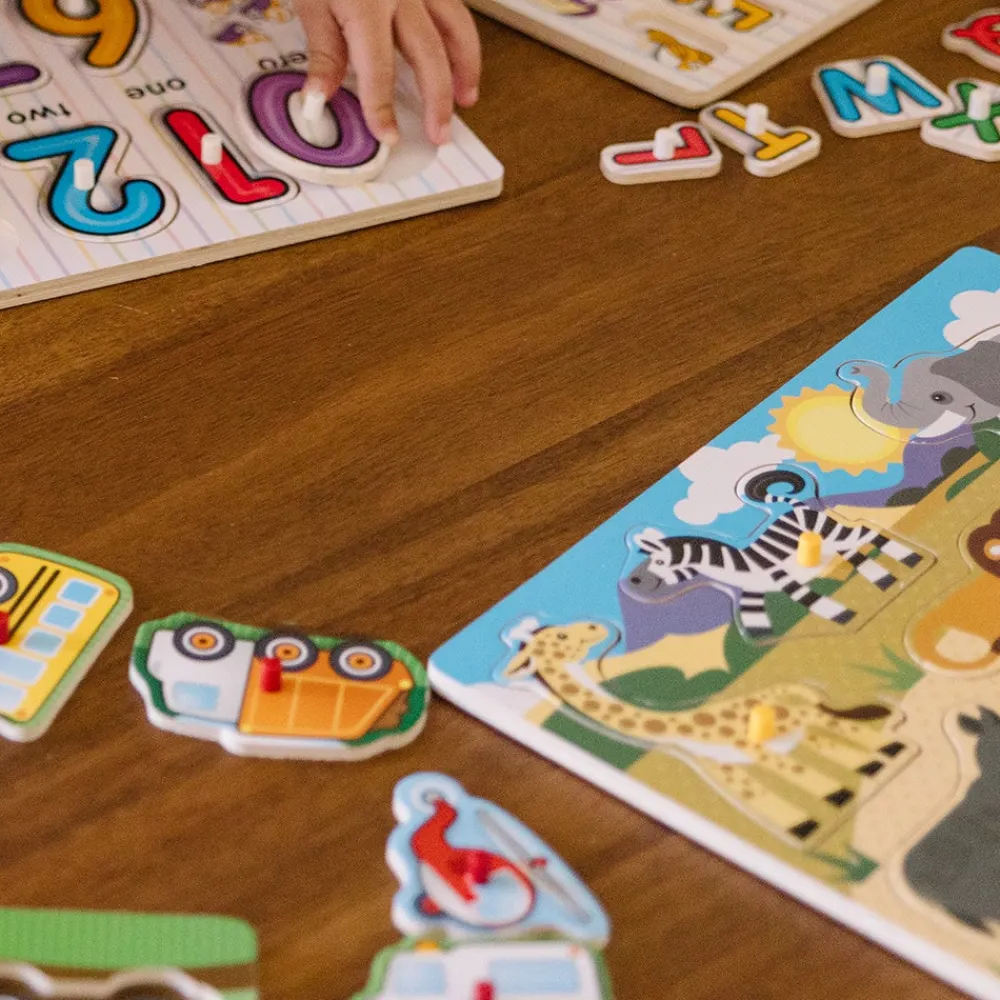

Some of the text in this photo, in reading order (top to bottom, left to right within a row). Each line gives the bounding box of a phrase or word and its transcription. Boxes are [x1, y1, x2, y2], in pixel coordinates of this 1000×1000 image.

[125, 78, 186, 99] one
[7, 103, 71, 125] two
[0, 125, 166, 236] 2
